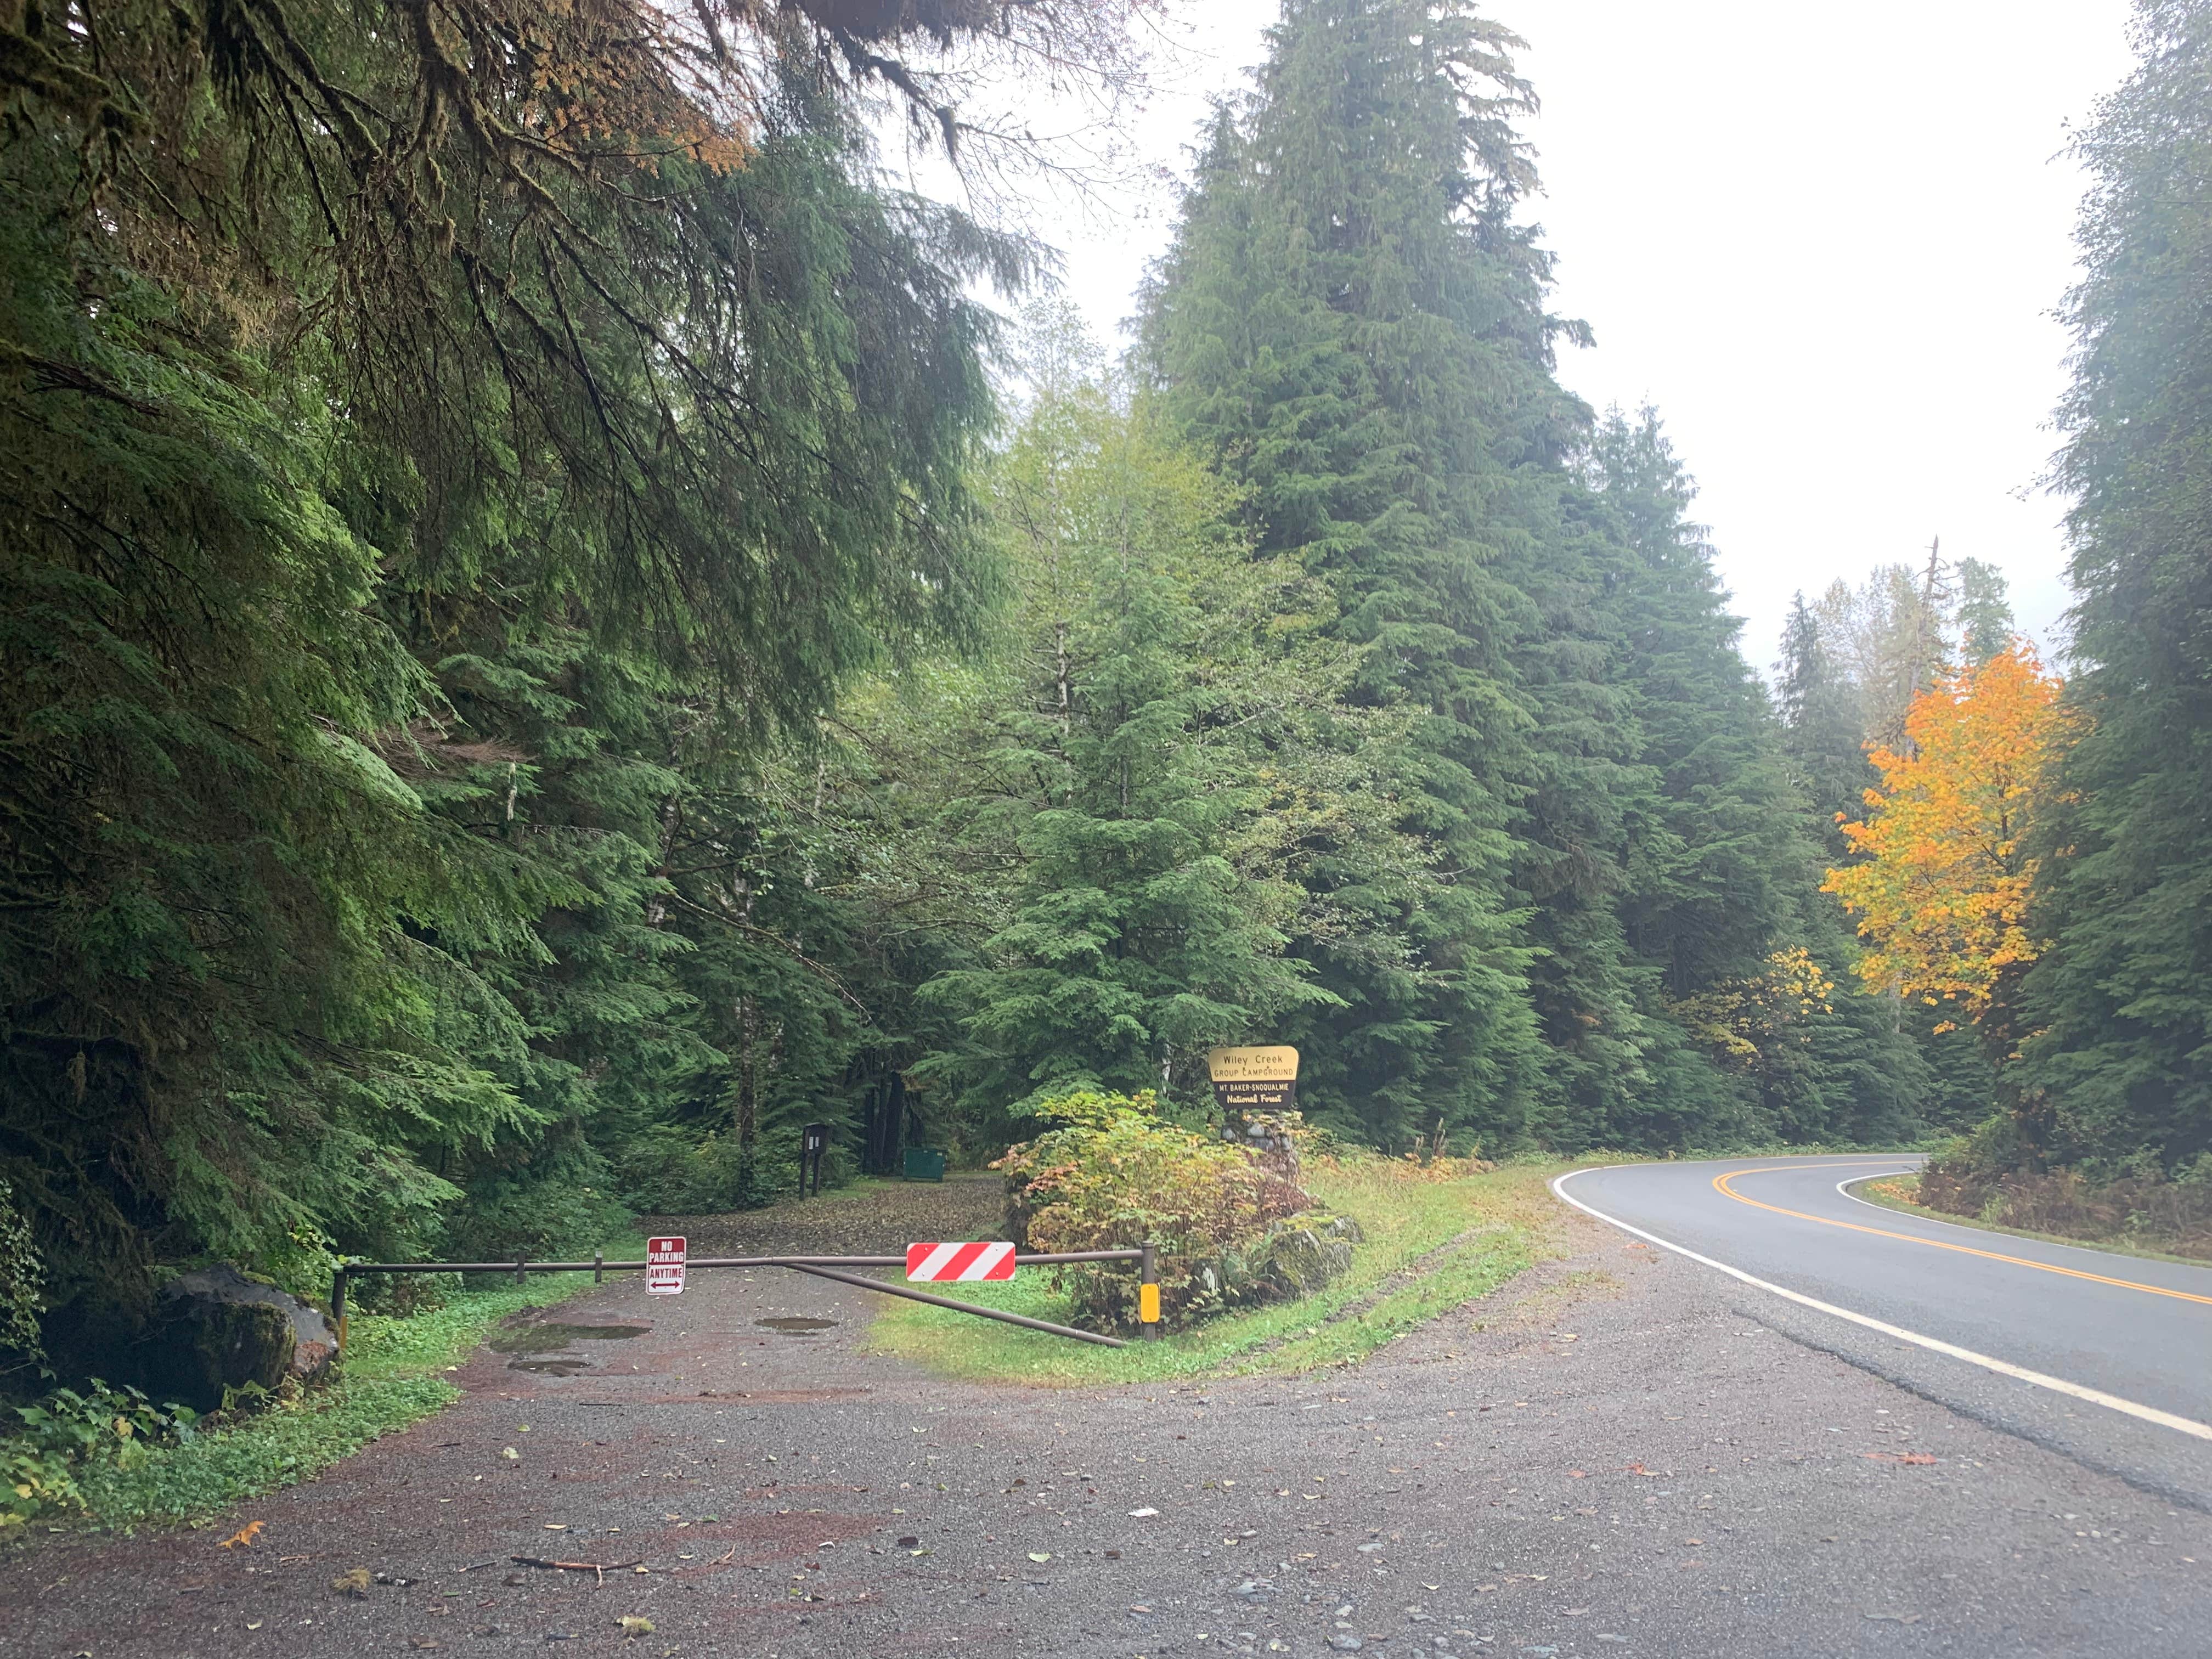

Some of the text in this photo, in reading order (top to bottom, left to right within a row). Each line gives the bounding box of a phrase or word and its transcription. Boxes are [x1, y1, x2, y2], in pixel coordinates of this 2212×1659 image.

[1223, 1055, 1283, 1065] Wiley Creek
[1243, 1068, 1293, 1076] CAMPGROUND
[1230, 1084, 1289, 1092] BAKER-SNOQUALMIE
[1227, 1093, 1282, 1104] National Forest
[661, 1241, 673, 1251] NO
[649, 1251, 684, 1263] PARKING
[650, 1268, 682, 1278] ANYTIME
